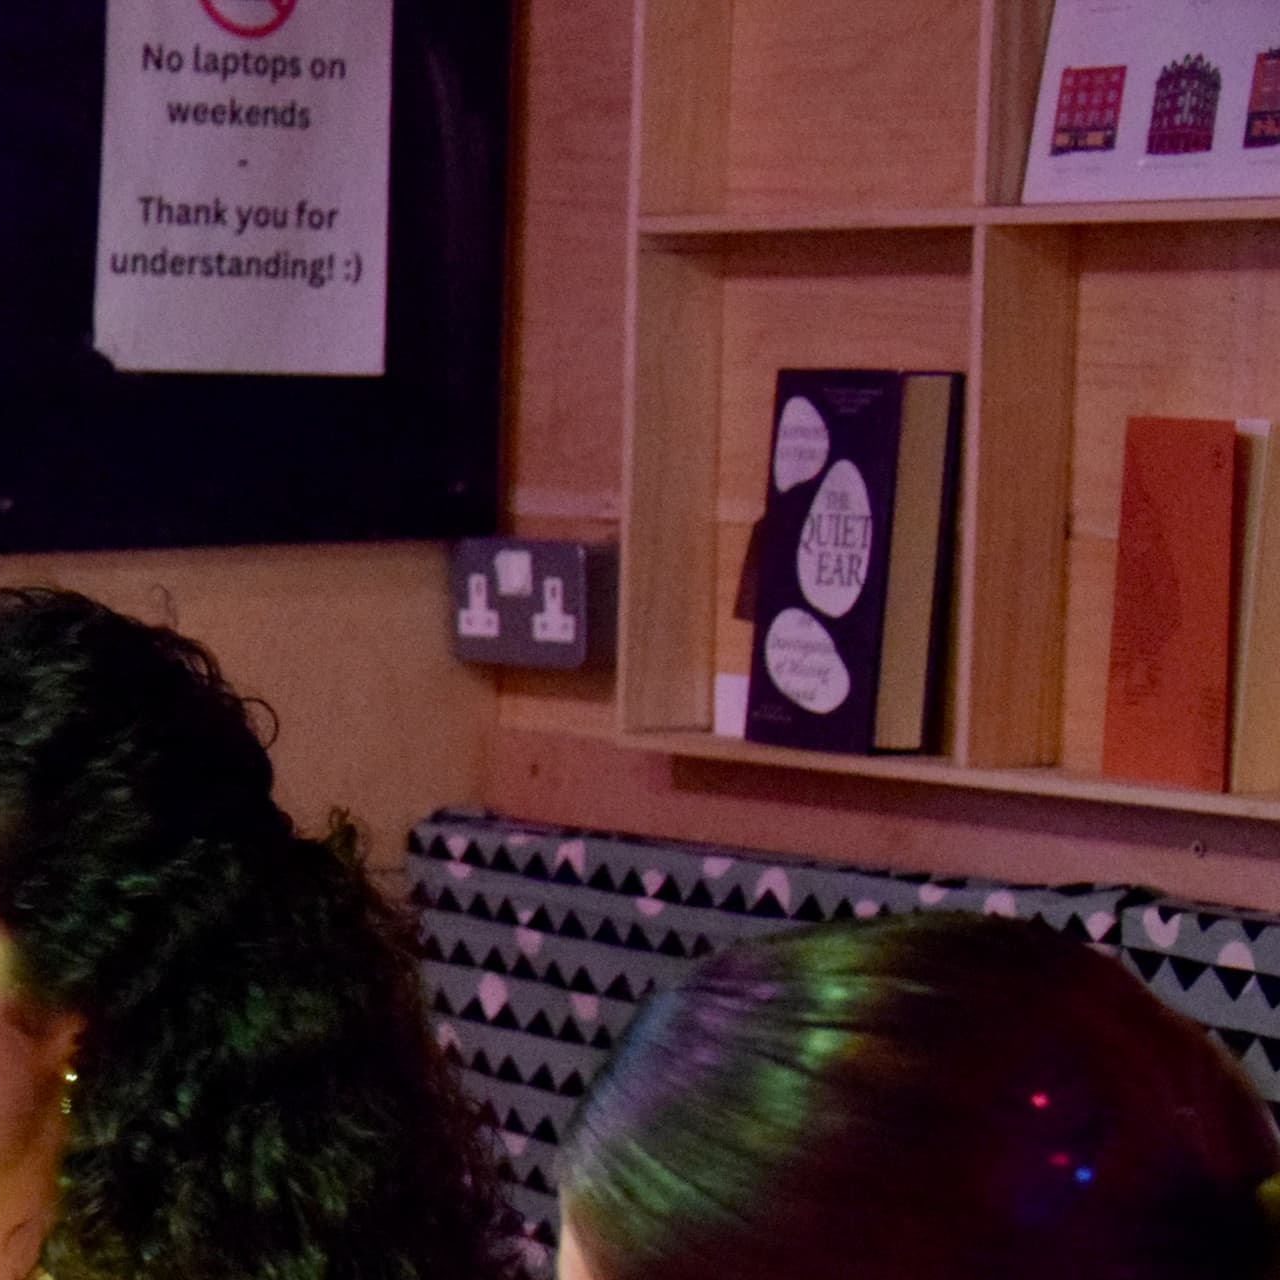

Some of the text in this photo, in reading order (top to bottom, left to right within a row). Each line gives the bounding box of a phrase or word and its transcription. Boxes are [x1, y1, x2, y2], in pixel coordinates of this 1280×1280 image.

[142, 43, 346, 83] No laptops on
[167, 99, 311, 130] weekends
[138, 197, 338, 236] Thank you for
[111, 248, 334, 288] understanding!
[801, 514, 871, 554] QUIET
[815, 552, 865, 587] EAR
